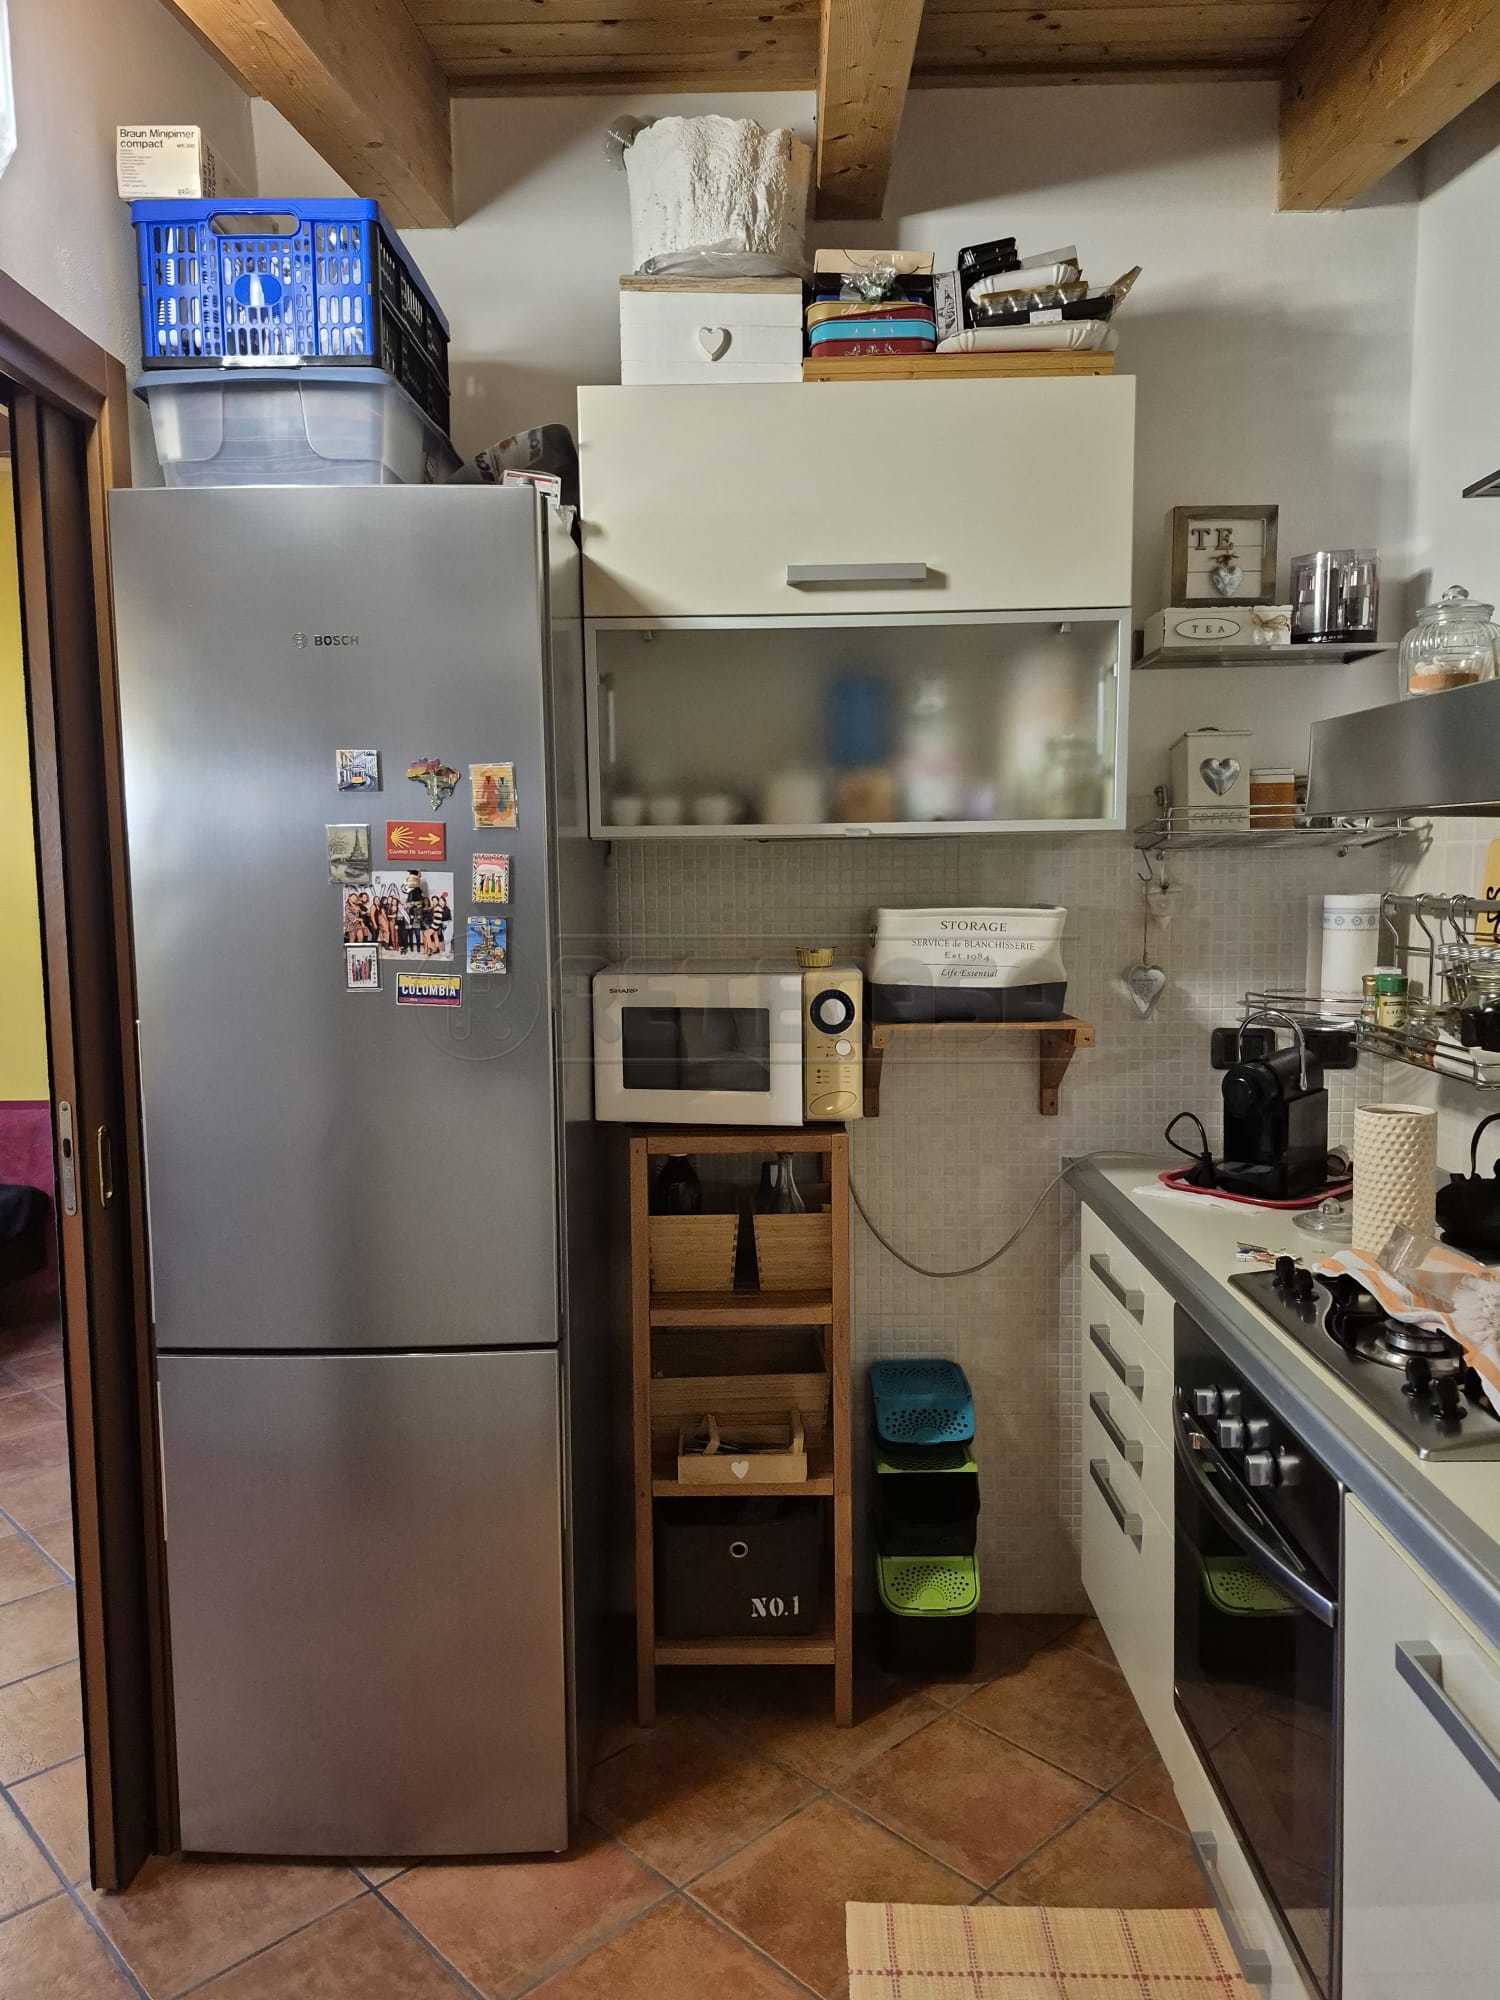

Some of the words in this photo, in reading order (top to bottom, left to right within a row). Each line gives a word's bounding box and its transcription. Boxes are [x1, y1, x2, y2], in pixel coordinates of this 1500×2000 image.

[119, 129, 147, 138] Braun
[149, 129, 194, 140] Minipimer
[120, 140, 163, 149] compact
[1191, 527, 1234, 550] TE
[1192, 624, 1225, 633] TEA
[314, 635, 359, 646] BOSCH
[940, 920, 1008, 932] STORAGE
[911, 938, 949, 948] SERVICE
[964, 940, 1036, 951] BLANCHISSERIE
[751, 1595, 799, 1617] NO.1
